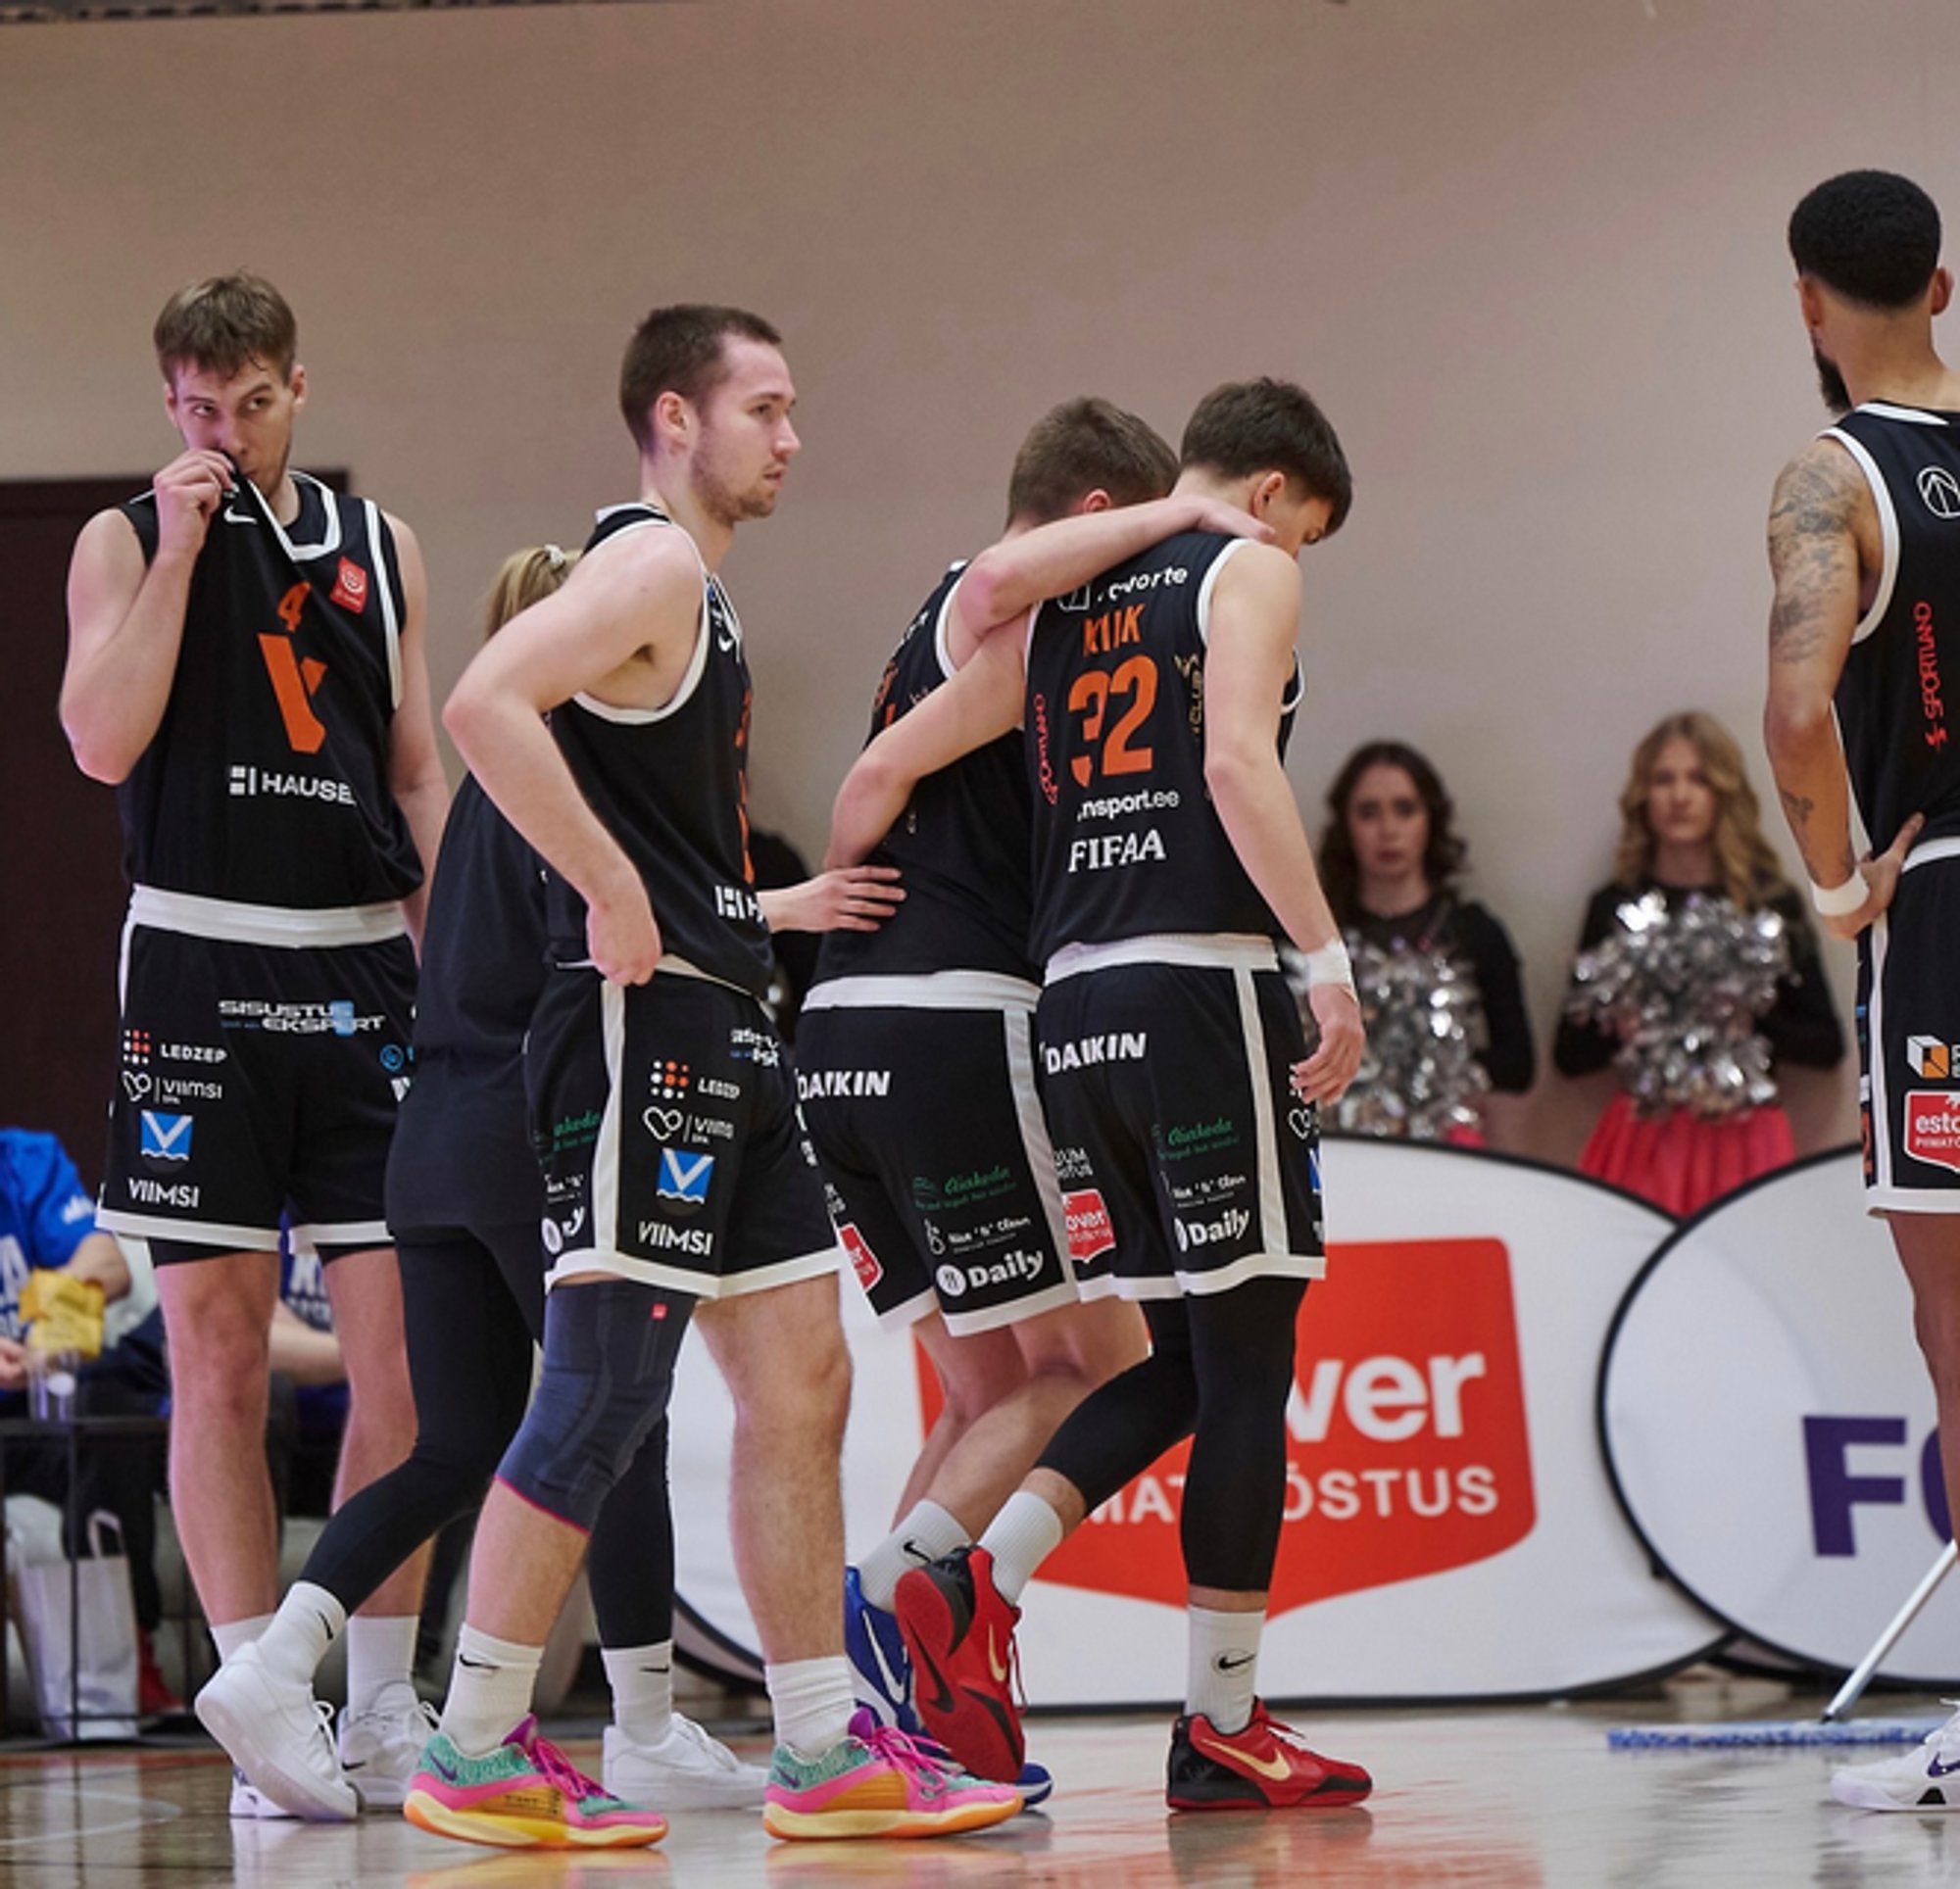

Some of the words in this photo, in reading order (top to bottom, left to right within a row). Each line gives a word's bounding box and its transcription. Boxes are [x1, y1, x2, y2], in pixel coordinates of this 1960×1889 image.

[277, 581, 311, 632] 4
[1068, 654, 1158, 788] 32
[1068, 829, 1166, 873] FIFAA
[160, 1042, 227, 1064] LEDZEP
[1045, 1033, 1146, 1075] DAIKIN
[798, 1071, 891, 1100] DAIKIN
[128, 1178, 200, 1208] VIIMSI
[639, 1222, 713, 1255] VIIMSI
[1188, 1208, 1250, 1246] Daily
[967, 1250, 1044, 1287] Daily
[1287, 1353, 1486, 1442] ver
